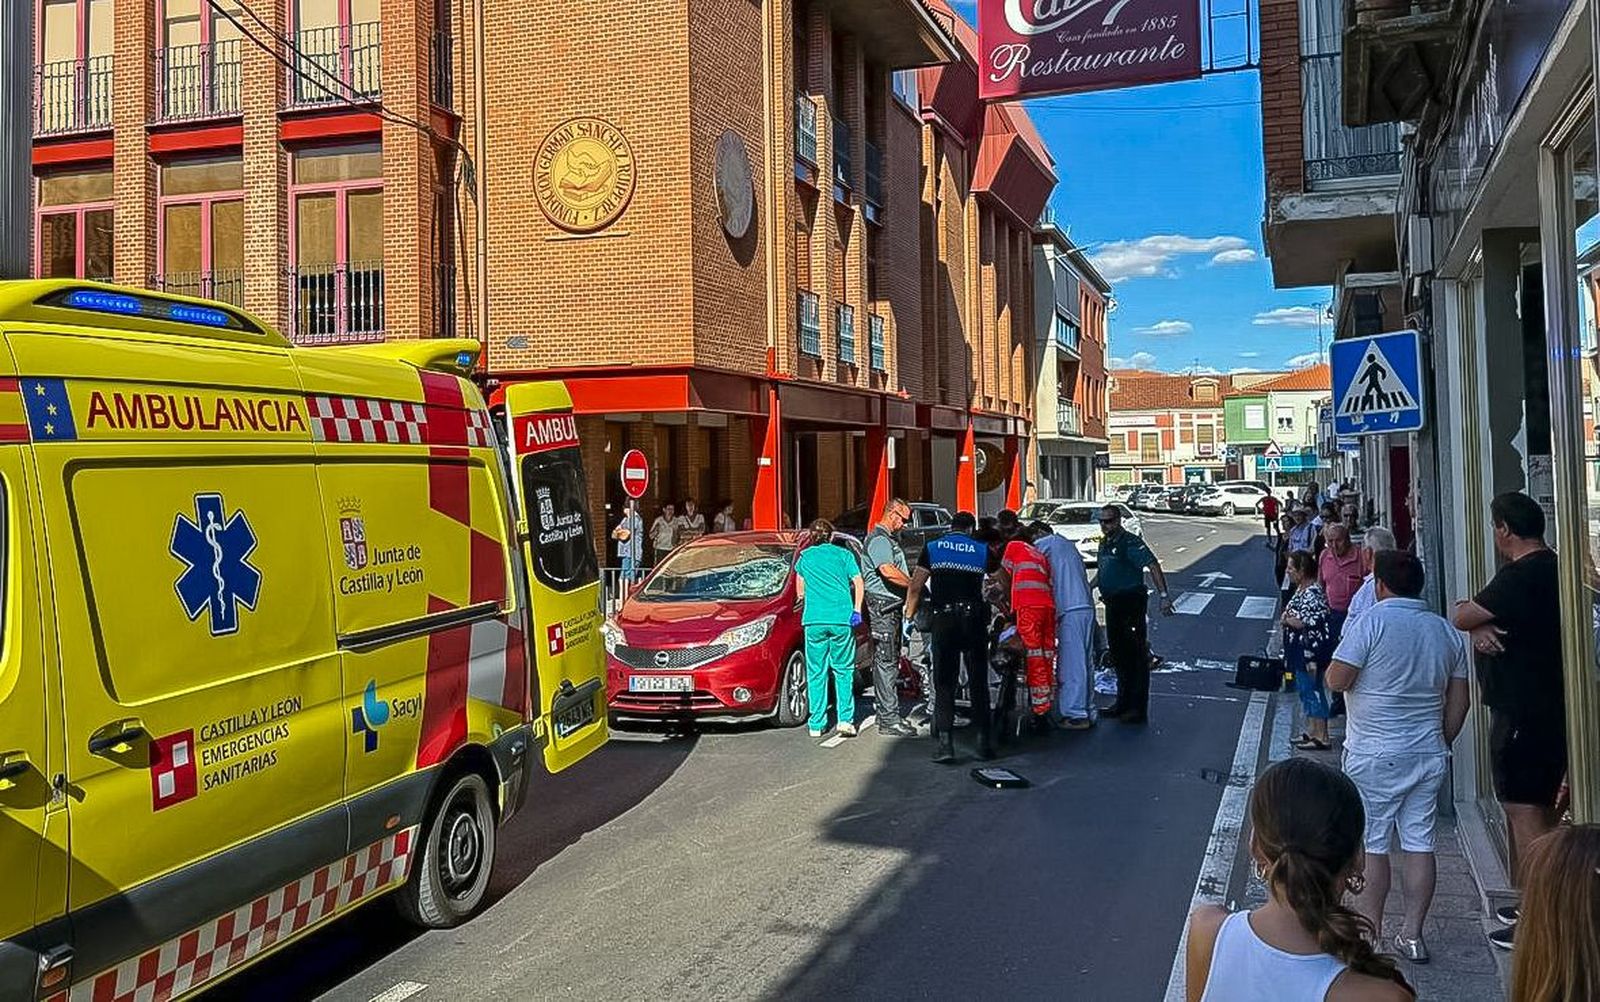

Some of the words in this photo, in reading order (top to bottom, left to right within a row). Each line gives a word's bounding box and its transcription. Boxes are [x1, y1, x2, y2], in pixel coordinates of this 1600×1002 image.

[1141, 15, 1178, 32] 1885
[989, 34, 1186, 82] Restaurante
[86, 391, 307, 432] AMBULANCIA
[372, 547, 404, 566] Junta
[406, 545, 421, 560] de
[339, 572, 384, 595] Castilla
[386, 572, 394, 593] y
[396, 566, 424, 586] León
[392, 692, 422, 718] Sacyl
[200, 711, 258, 743] CASTILLA
[258, 707, 269, 722] Y
[202, 723, 290, 766] EMERGENCIAS
[203, 749, 278, 791] SANITARIAS
